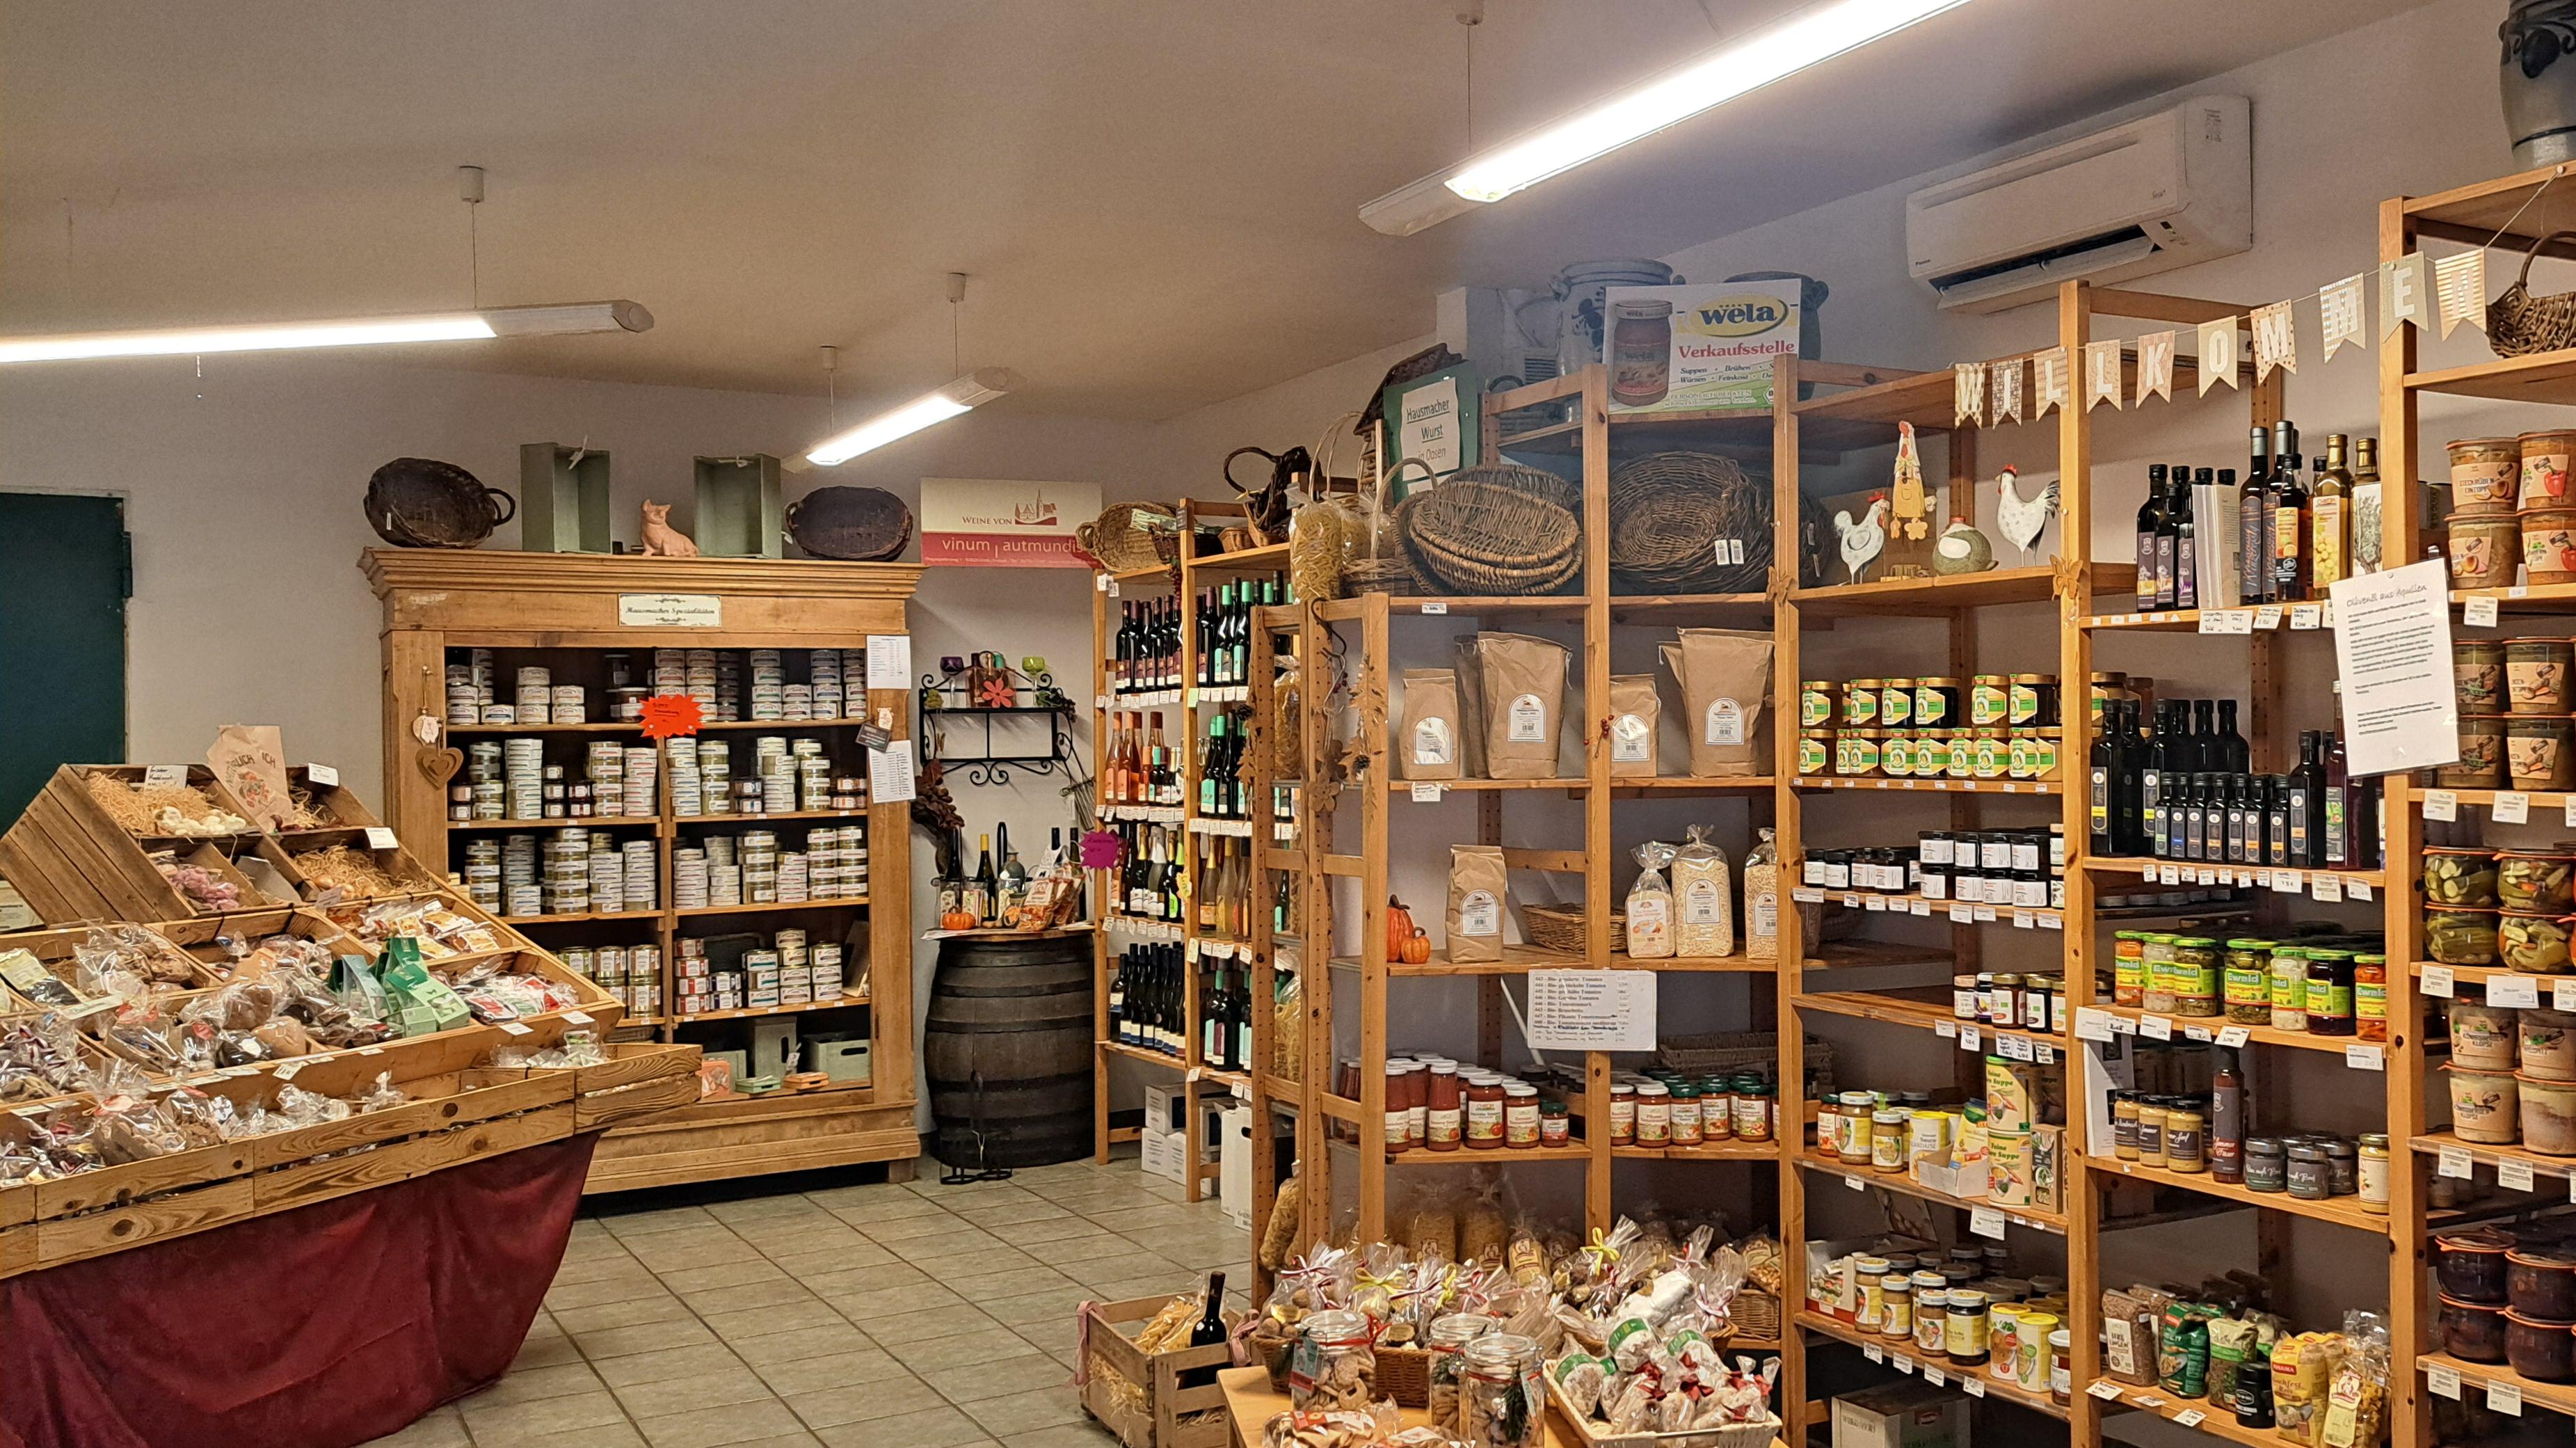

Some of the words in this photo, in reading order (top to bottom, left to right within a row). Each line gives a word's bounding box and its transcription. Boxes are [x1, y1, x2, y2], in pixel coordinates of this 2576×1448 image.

[1678, 340, 1795, 360] Verkaufsstelle
[1406, 399, 1450, 421] Hausmacher
[1421, 424, 1443, 440] Wurst
[1426, 447, 1446, 461] Dosen
[993, 517, 1013, 525] VON
[941, 537, 990, 552] vinum
[1002, 540, 1083, 554] autmundis
[2379, 591, 2394, 600] aus
[2227, 972, 2260, 983] Ewald
[2272, 979, 2288, 987] ald
[1992, 1078, 2014, 1087] Suppe
[1991, 1142, 2007, 1151] Feine
[1999, 1151, 2020, 1160] Suppe
